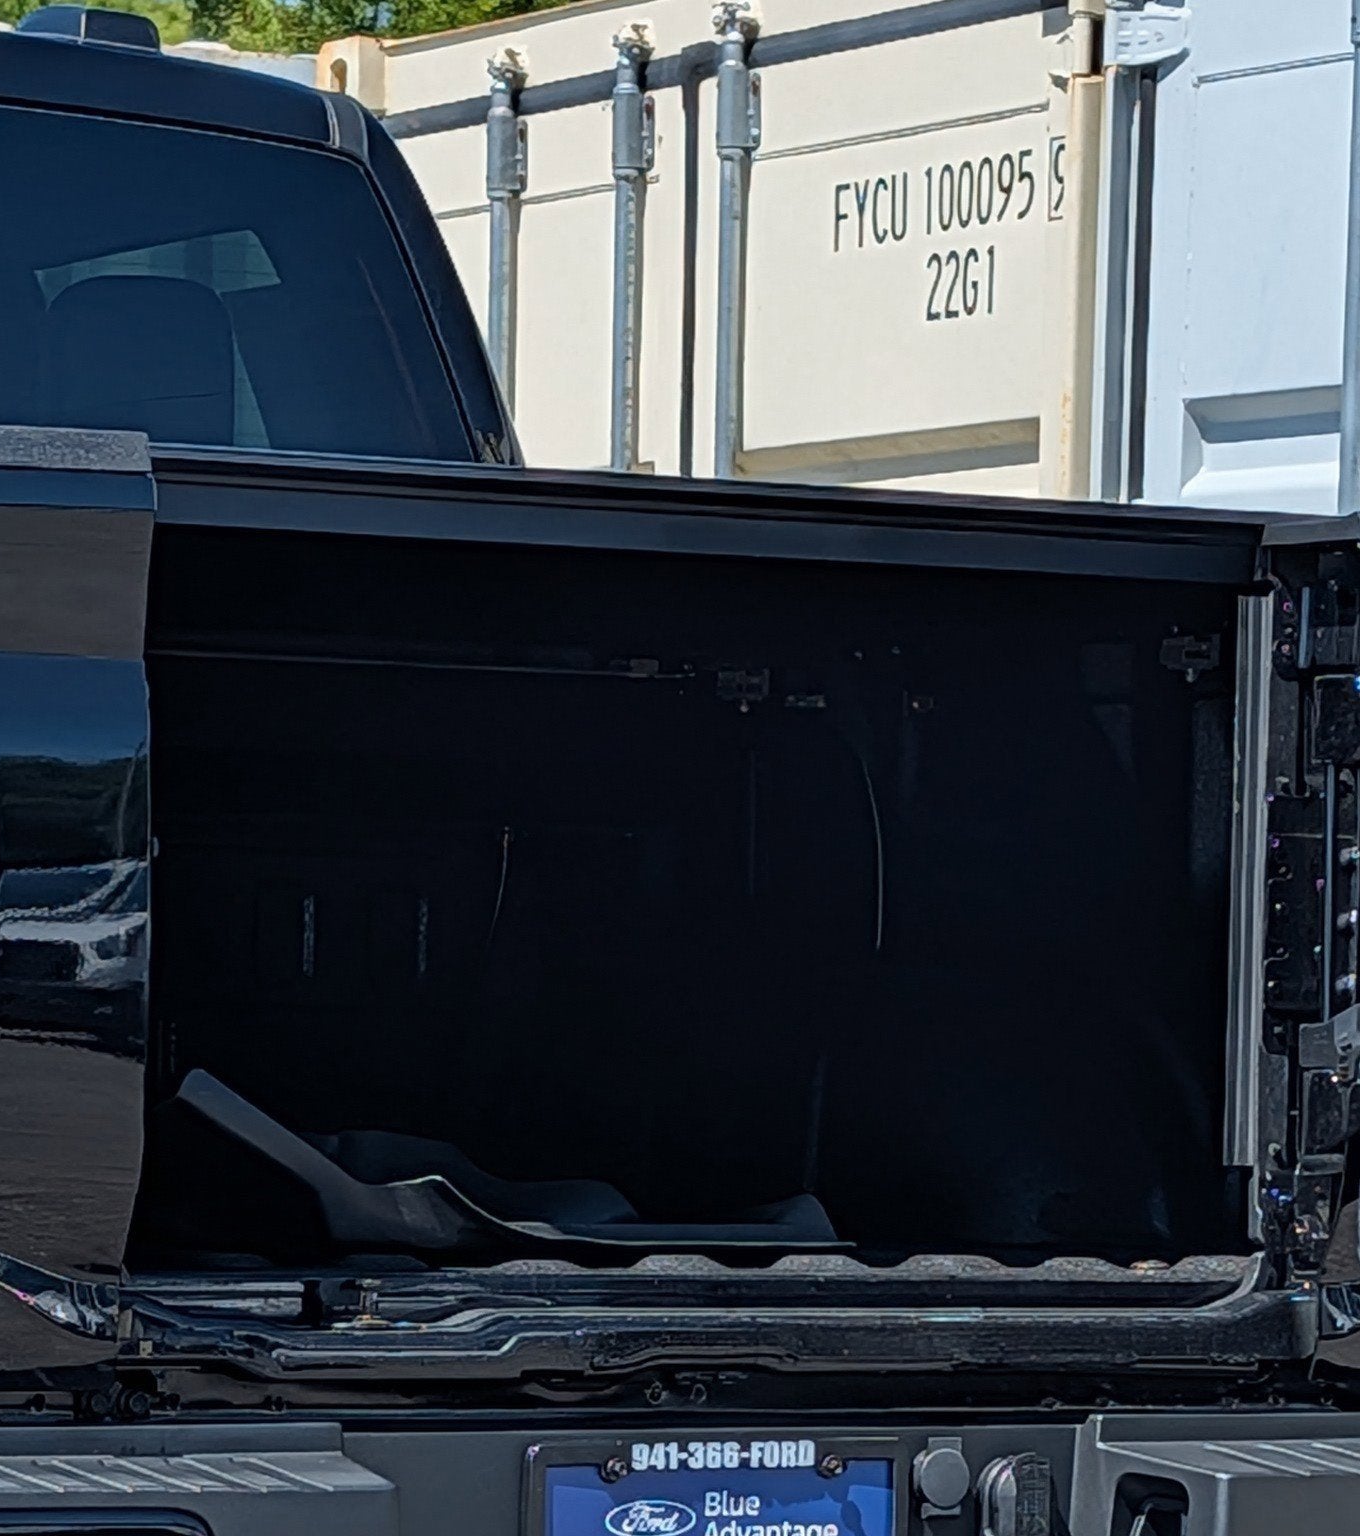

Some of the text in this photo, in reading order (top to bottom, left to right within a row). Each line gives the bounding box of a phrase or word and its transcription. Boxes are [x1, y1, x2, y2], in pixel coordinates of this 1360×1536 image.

[834, 171, 908, 252] FYCU
[925, 149, 1034, 235] 100095
[926, 245, 994, 321] 22G1
[631, 1439, 816, 1471] 941-366-FORD
[704, 1490, 761, 1517] Blue
